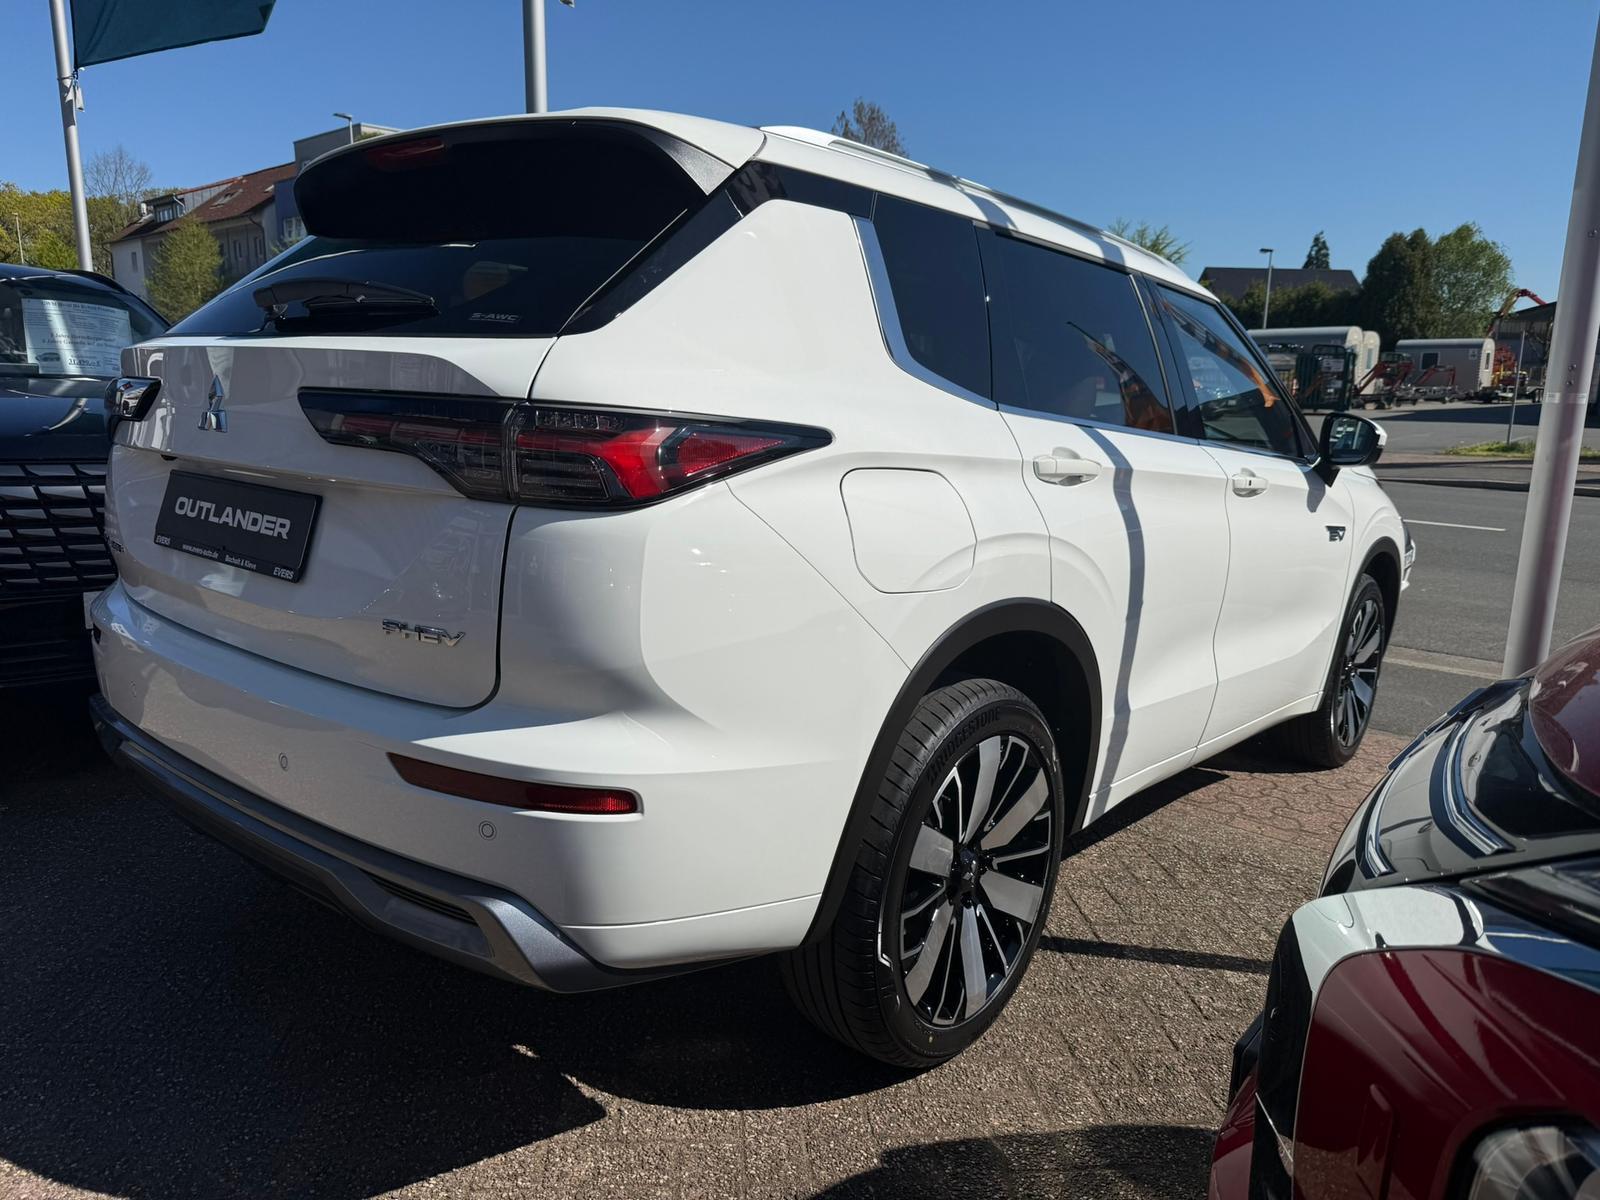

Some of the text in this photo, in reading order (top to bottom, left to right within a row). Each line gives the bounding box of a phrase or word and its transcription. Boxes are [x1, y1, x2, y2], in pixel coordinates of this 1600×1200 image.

[471, 312, 519, 321] S-AWC
[174, 496, 291, 540] OUTLANDER
[156, 535, 171, 546] EVERS
[273, 566, 295, 580] EVERS
[927, 706, 1001, 787] BRIDGESTONE
